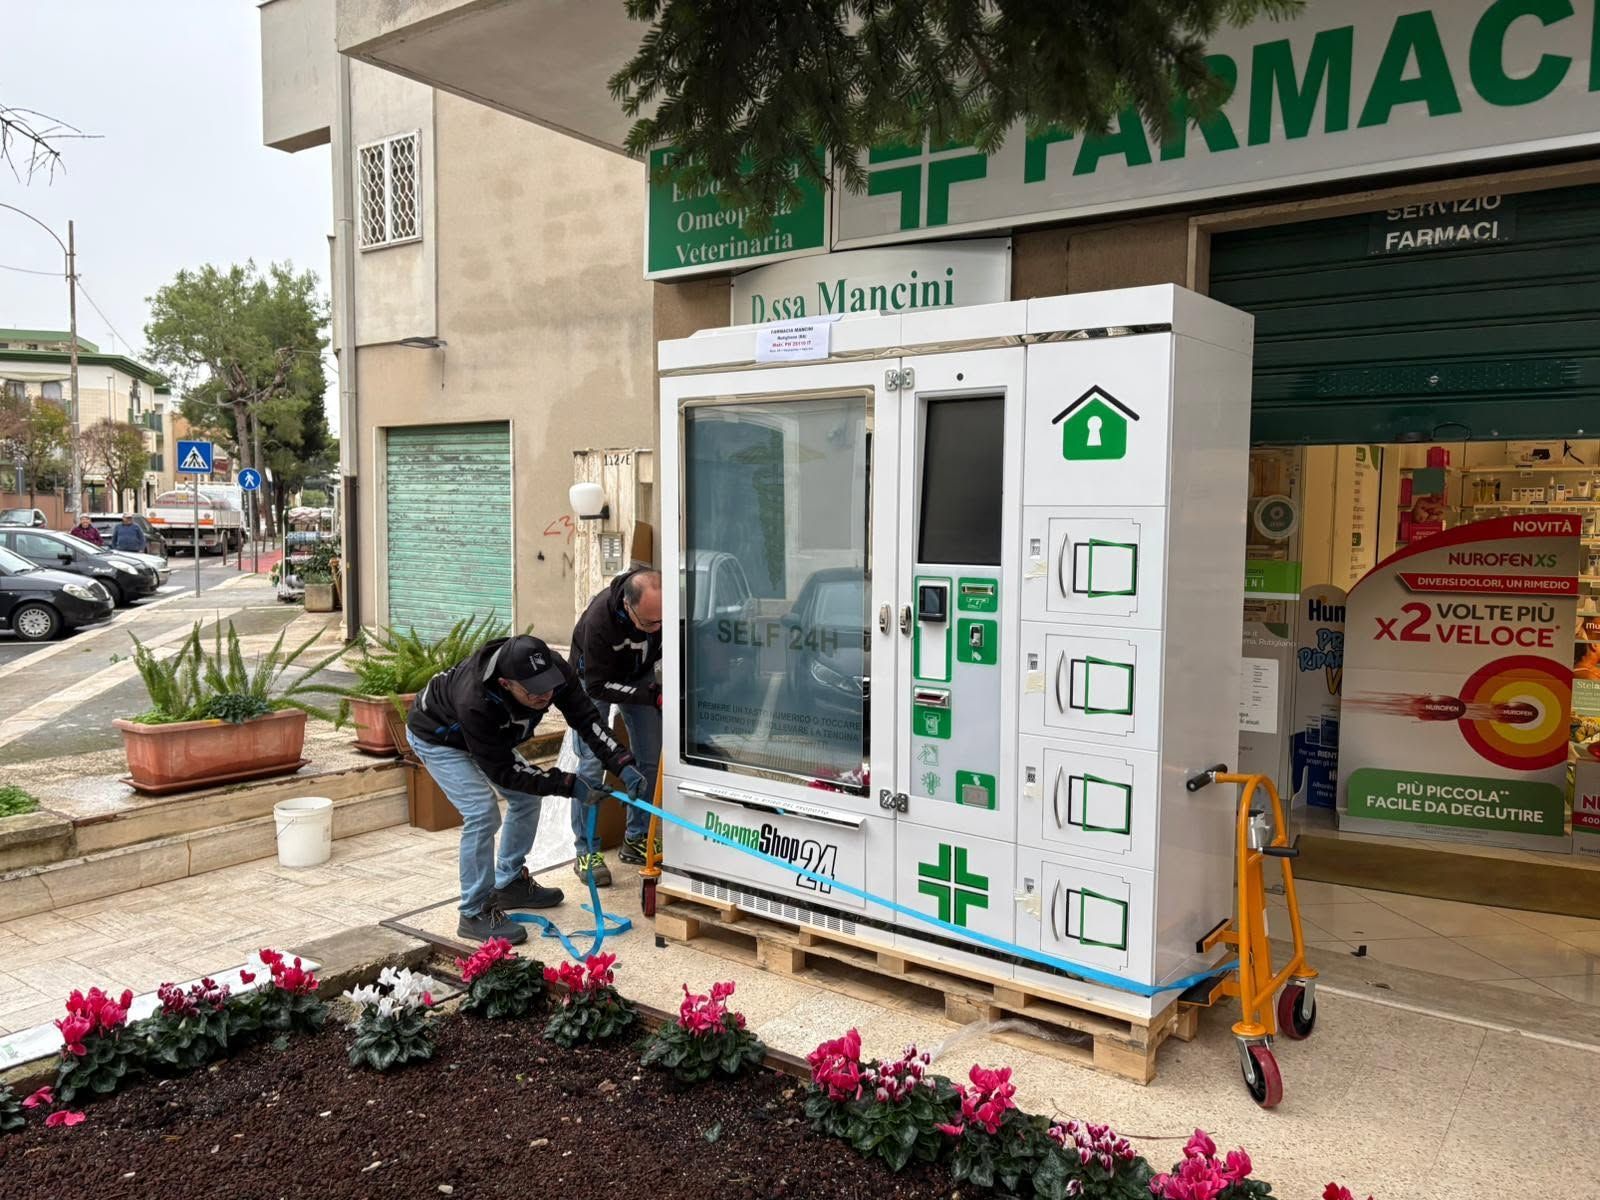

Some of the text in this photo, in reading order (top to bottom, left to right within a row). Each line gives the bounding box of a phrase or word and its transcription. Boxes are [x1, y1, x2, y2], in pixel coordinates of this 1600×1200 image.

[676, 199, 792, 233] Omeopia
[1386, 195, 1501, 221] SERVIZIO
[1385, 221, 1499, 250] FARMACI
[675, 228, 793, 265] Veterinaria
[750, 267, 955, 325] D.ssa Mancini
[1512, 518, 1573, 534] NOVITÀ
[1417, 577, 1459, 587] DIVERSI
[1505, 579, 1522, 589] UN
[1523, 580, 1570, 590] RIMEDIO
[1436, 602, 1555, 623] VOLTE PIÙ
[717, 619, 839, 654] SELF 24H
[1425, 704, 1460, 712] NUROFEN
[1503, 709, 1534, 717] NUROFEN
[763, 720, 809, 735] OLLEVARE
[821, 717, 861, 732] TOCCARE
[1397, 781, 1423, 796] PIÙ
[1366, 795, 1544, 823] FACILE DA DEGLUTIRE
